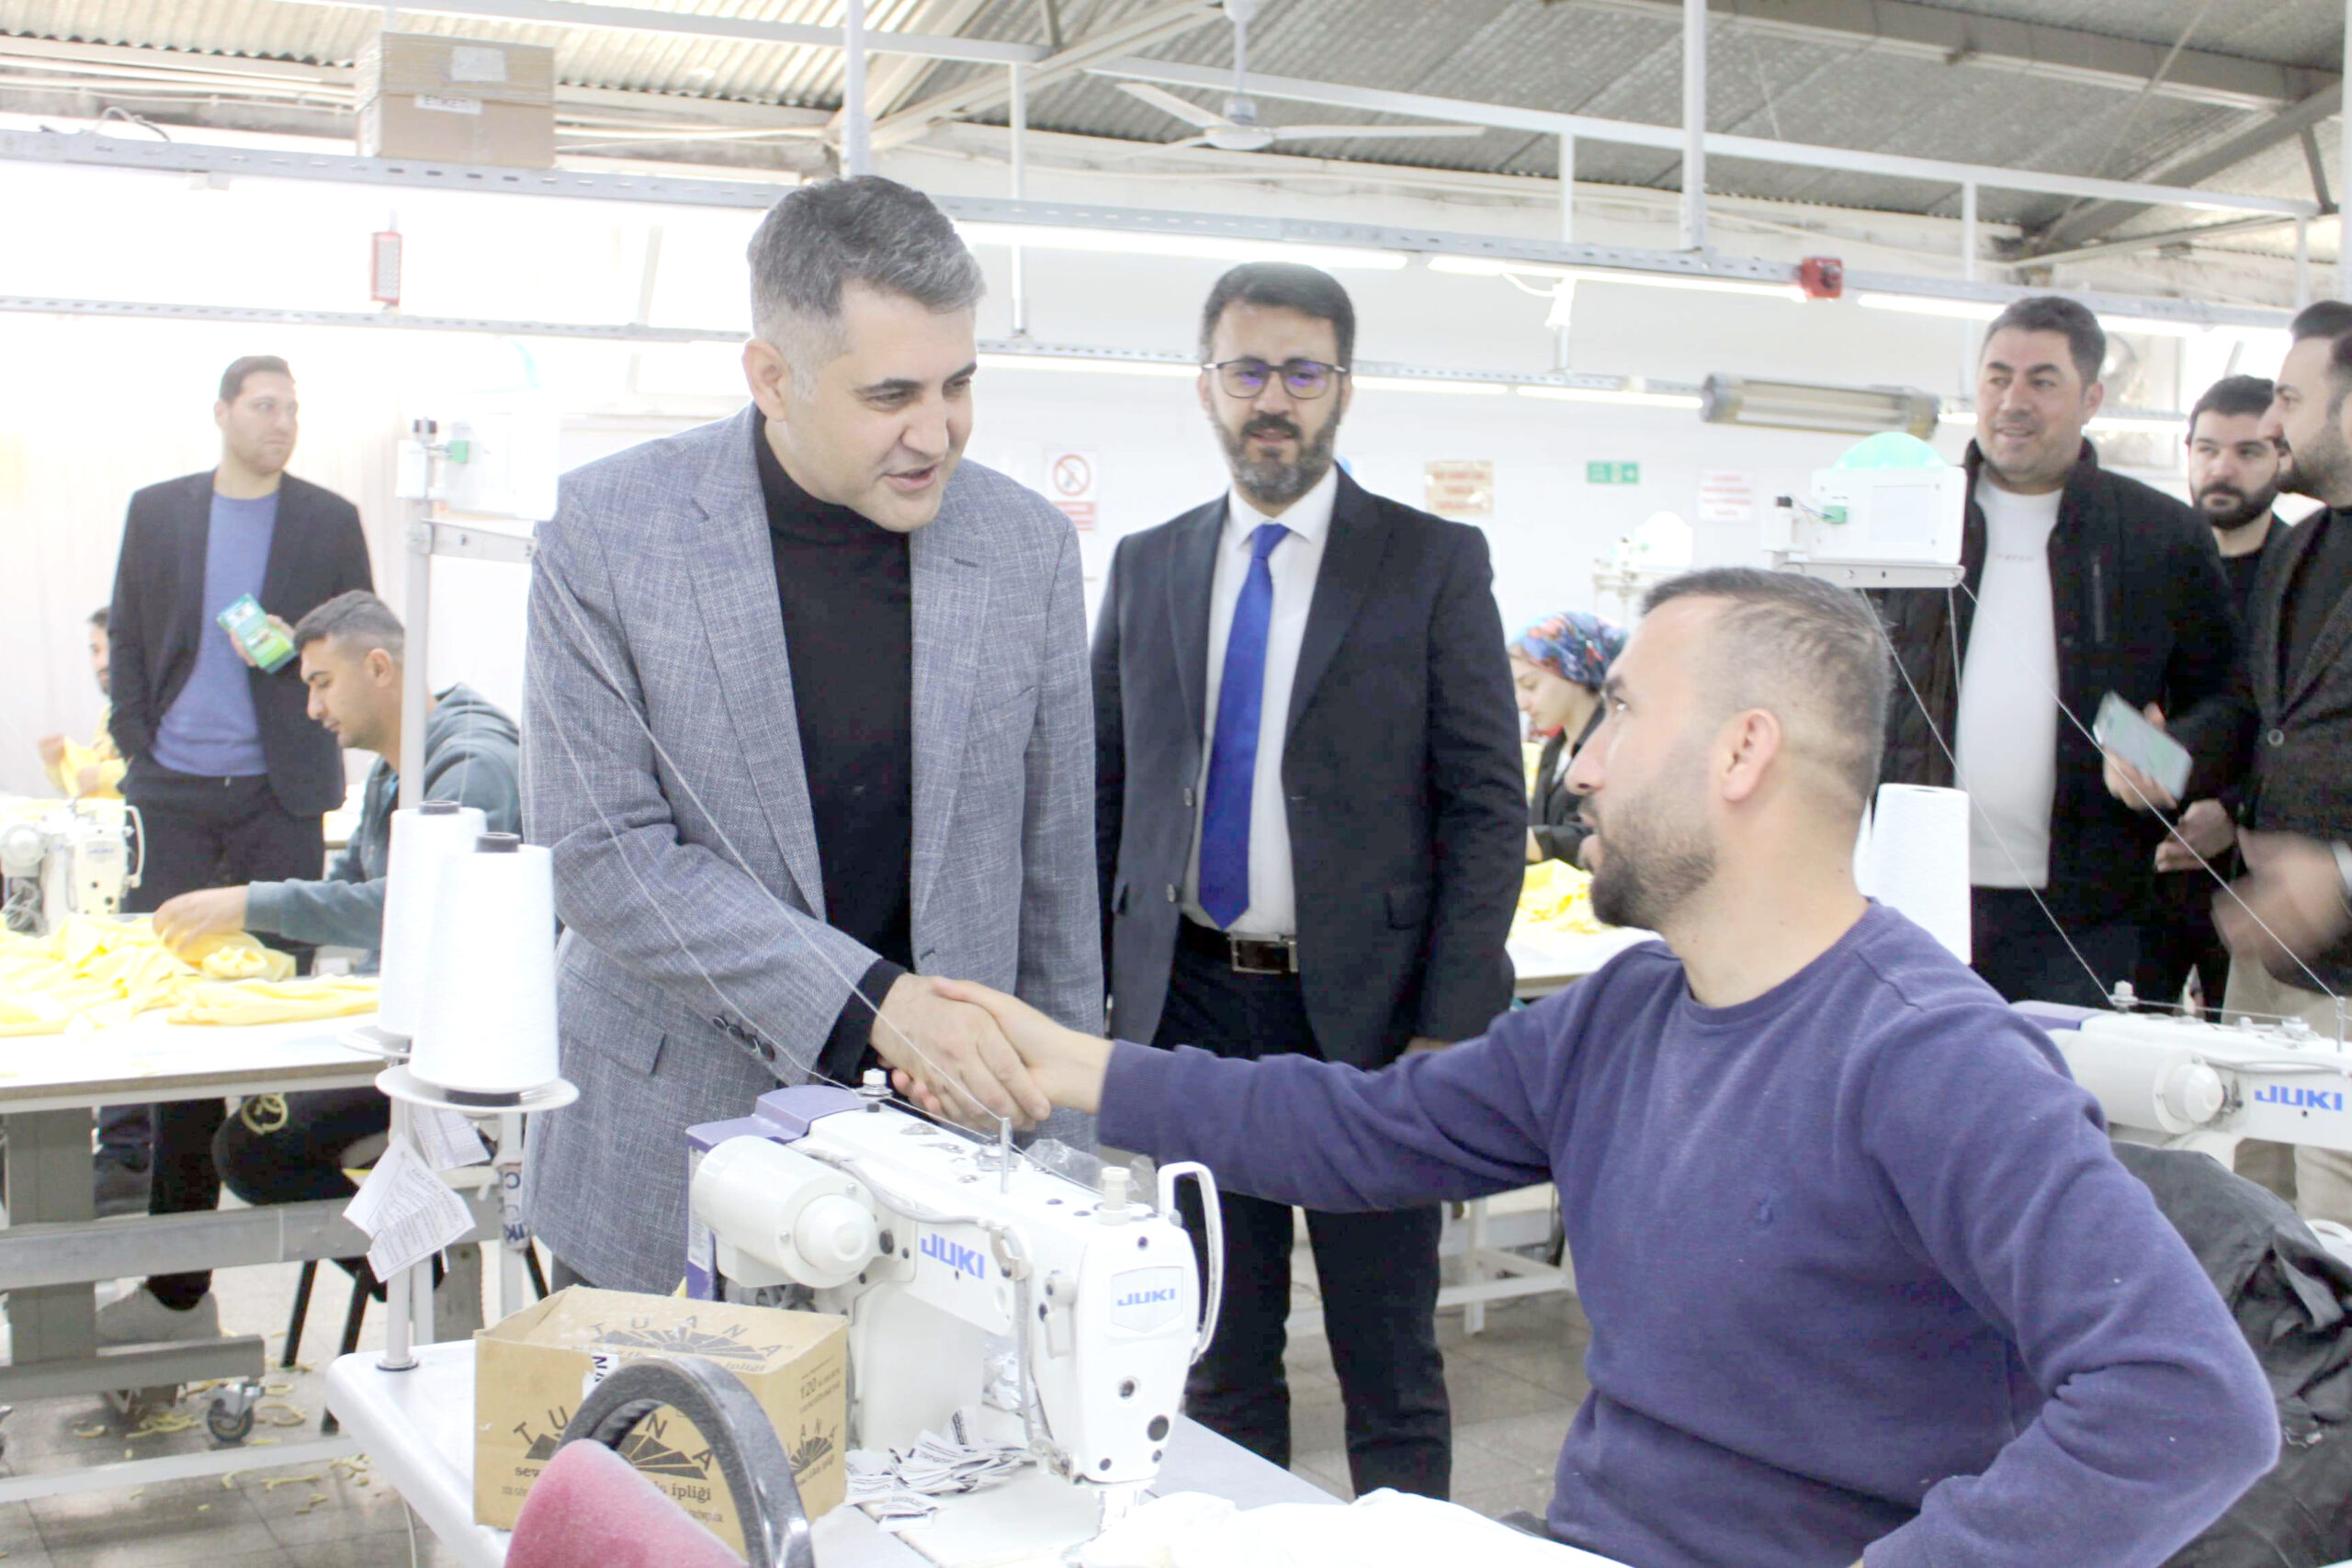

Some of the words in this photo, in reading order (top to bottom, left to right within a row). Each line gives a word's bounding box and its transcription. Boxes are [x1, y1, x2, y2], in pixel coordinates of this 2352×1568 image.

[2255, 1085, 2343, 1111] JUKI
[921, 1233, 985, 1280] JUKI
[1117, 1288, 1176, 1306] JUKI
[513, 1405, 715, 1471] TUNA
